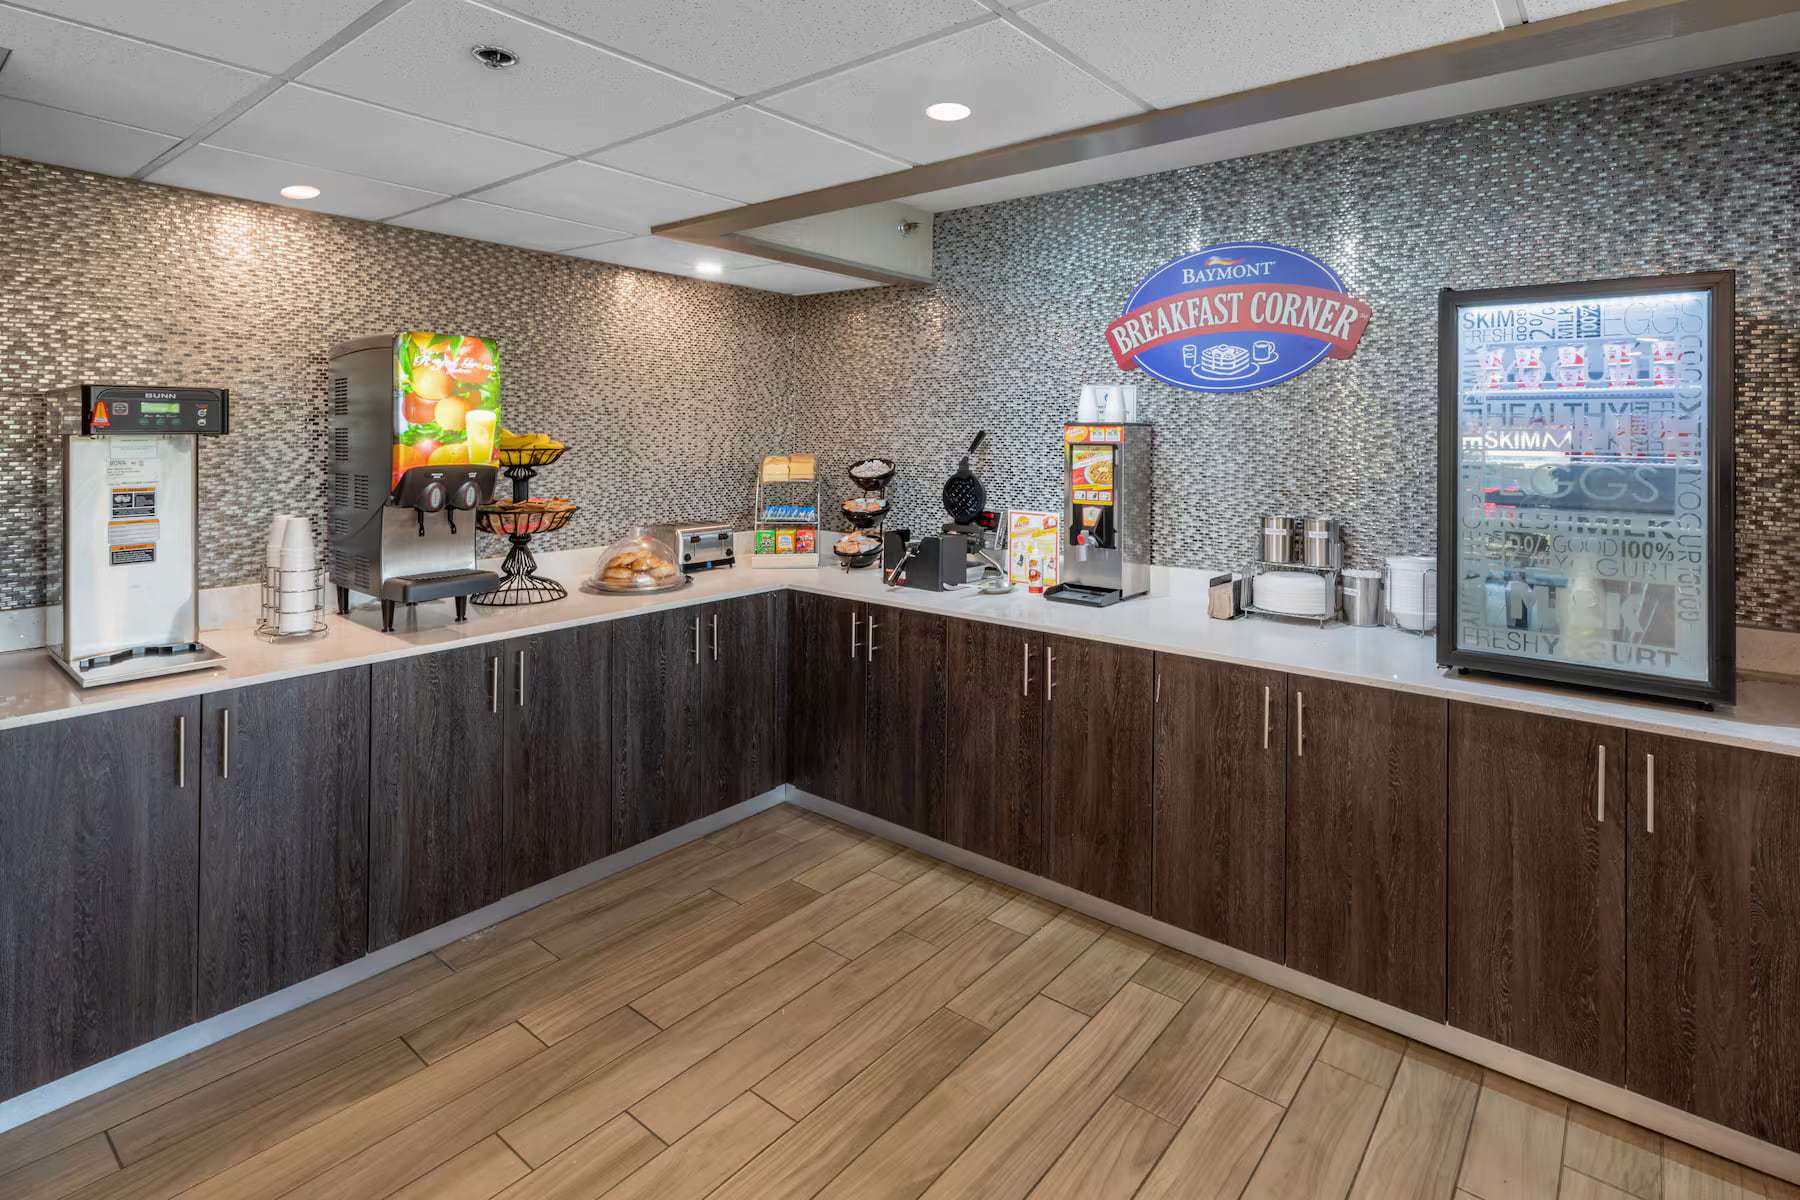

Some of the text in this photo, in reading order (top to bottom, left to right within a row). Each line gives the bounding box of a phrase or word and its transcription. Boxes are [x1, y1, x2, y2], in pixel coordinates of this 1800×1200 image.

[1182, 261, 1274, 285] BAYMONT
[1111, 291, 1358, 355] BREAKFAST CORNER
[1463, 310, 1515, 331] SKIM
[1484, 431, 1540, 450] SKIM
[1621, 541, 1675, 561] 100%
[1540, 634, 1678, 668] YURT
